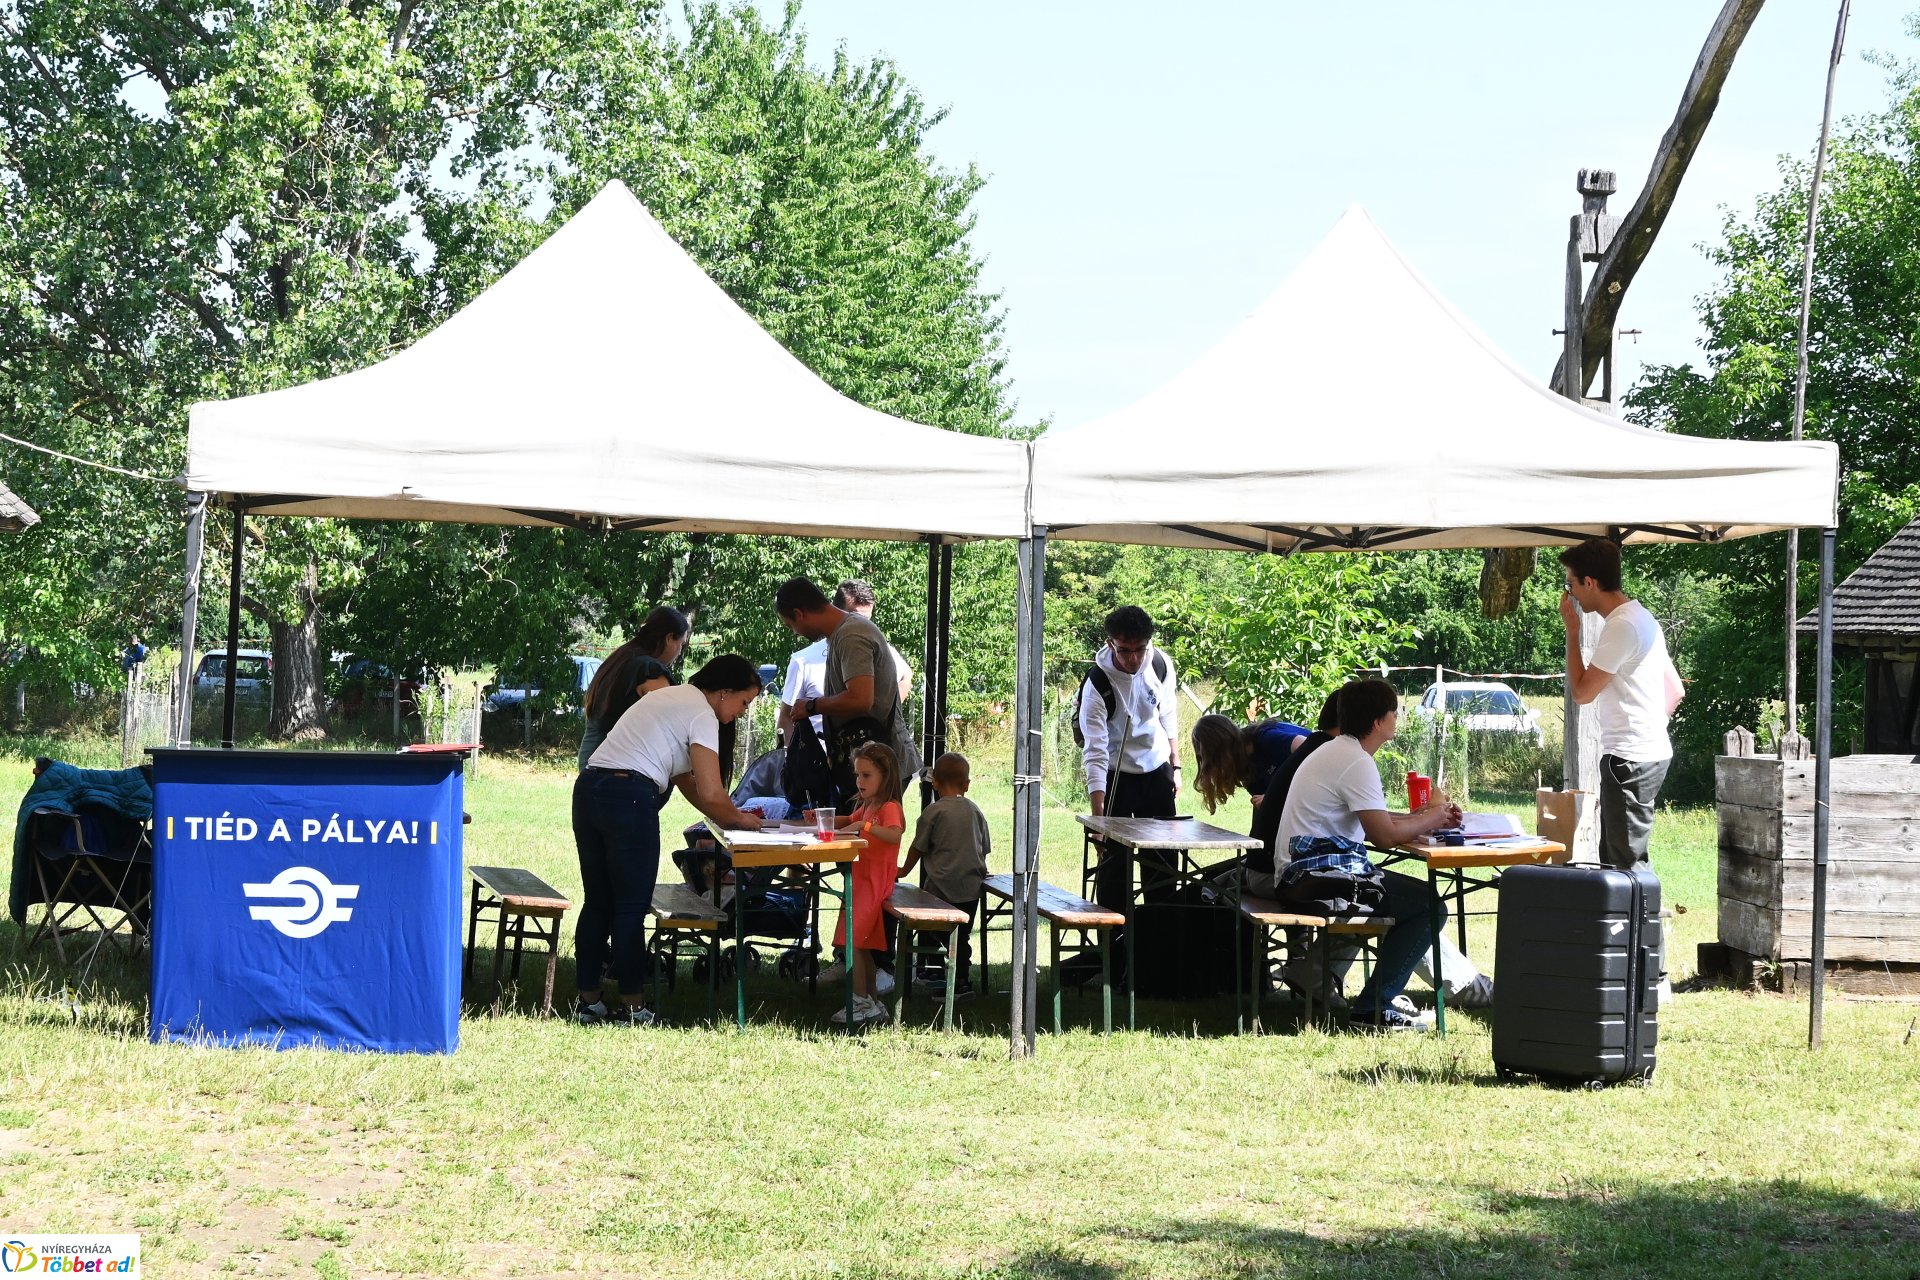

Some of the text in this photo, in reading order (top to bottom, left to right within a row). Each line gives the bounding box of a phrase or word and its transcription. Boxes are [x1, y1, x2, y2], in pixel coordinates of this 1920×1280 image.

[184, 811, 418, 844] TIÉD A PÁLYA!
